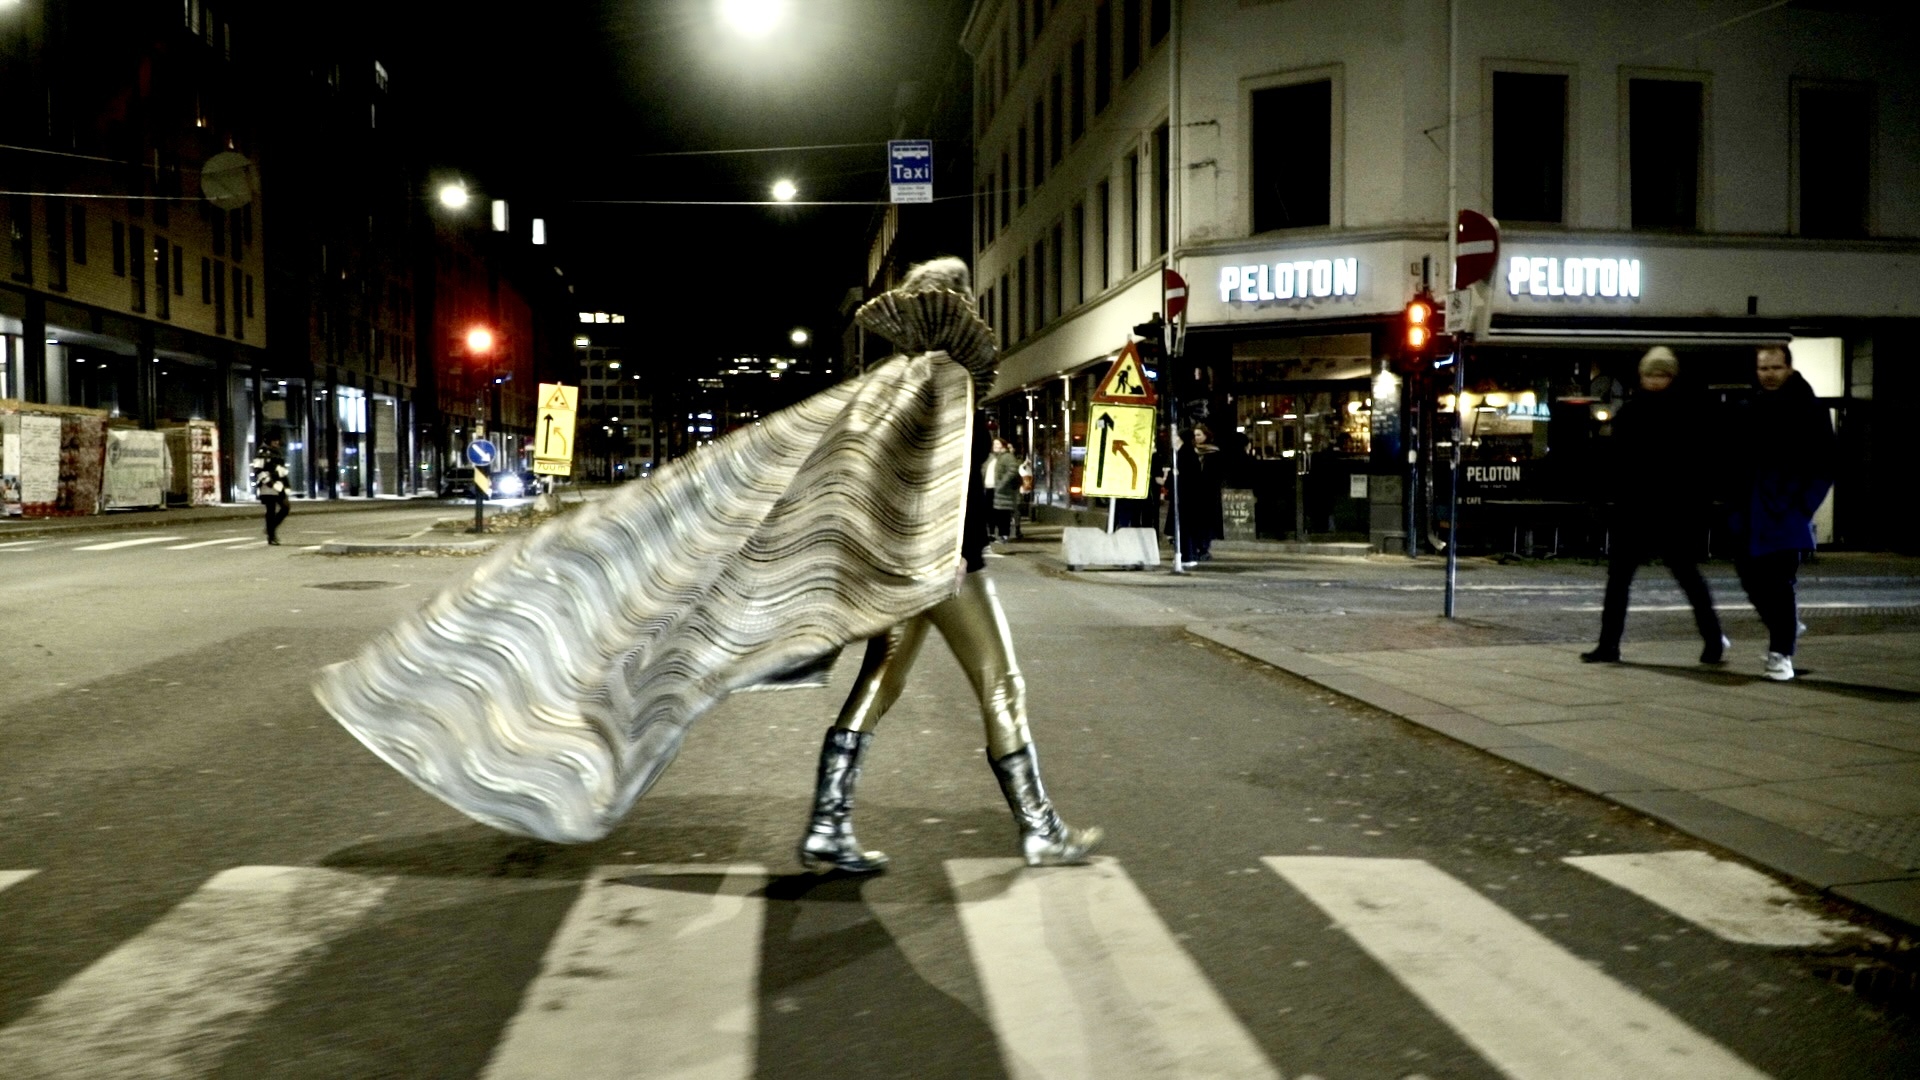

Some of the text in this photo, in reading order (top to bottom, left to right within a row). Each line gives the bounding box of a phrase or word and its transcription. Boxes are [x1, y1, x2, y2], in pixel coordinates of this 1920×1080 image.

[893, 164, 929, 179] Taxi
[1220, 257, 1358, 302] PELOTON
[1508, 256, 1640, 297] PELOTON
[1466, 465, 1521, 482] PELOTON
